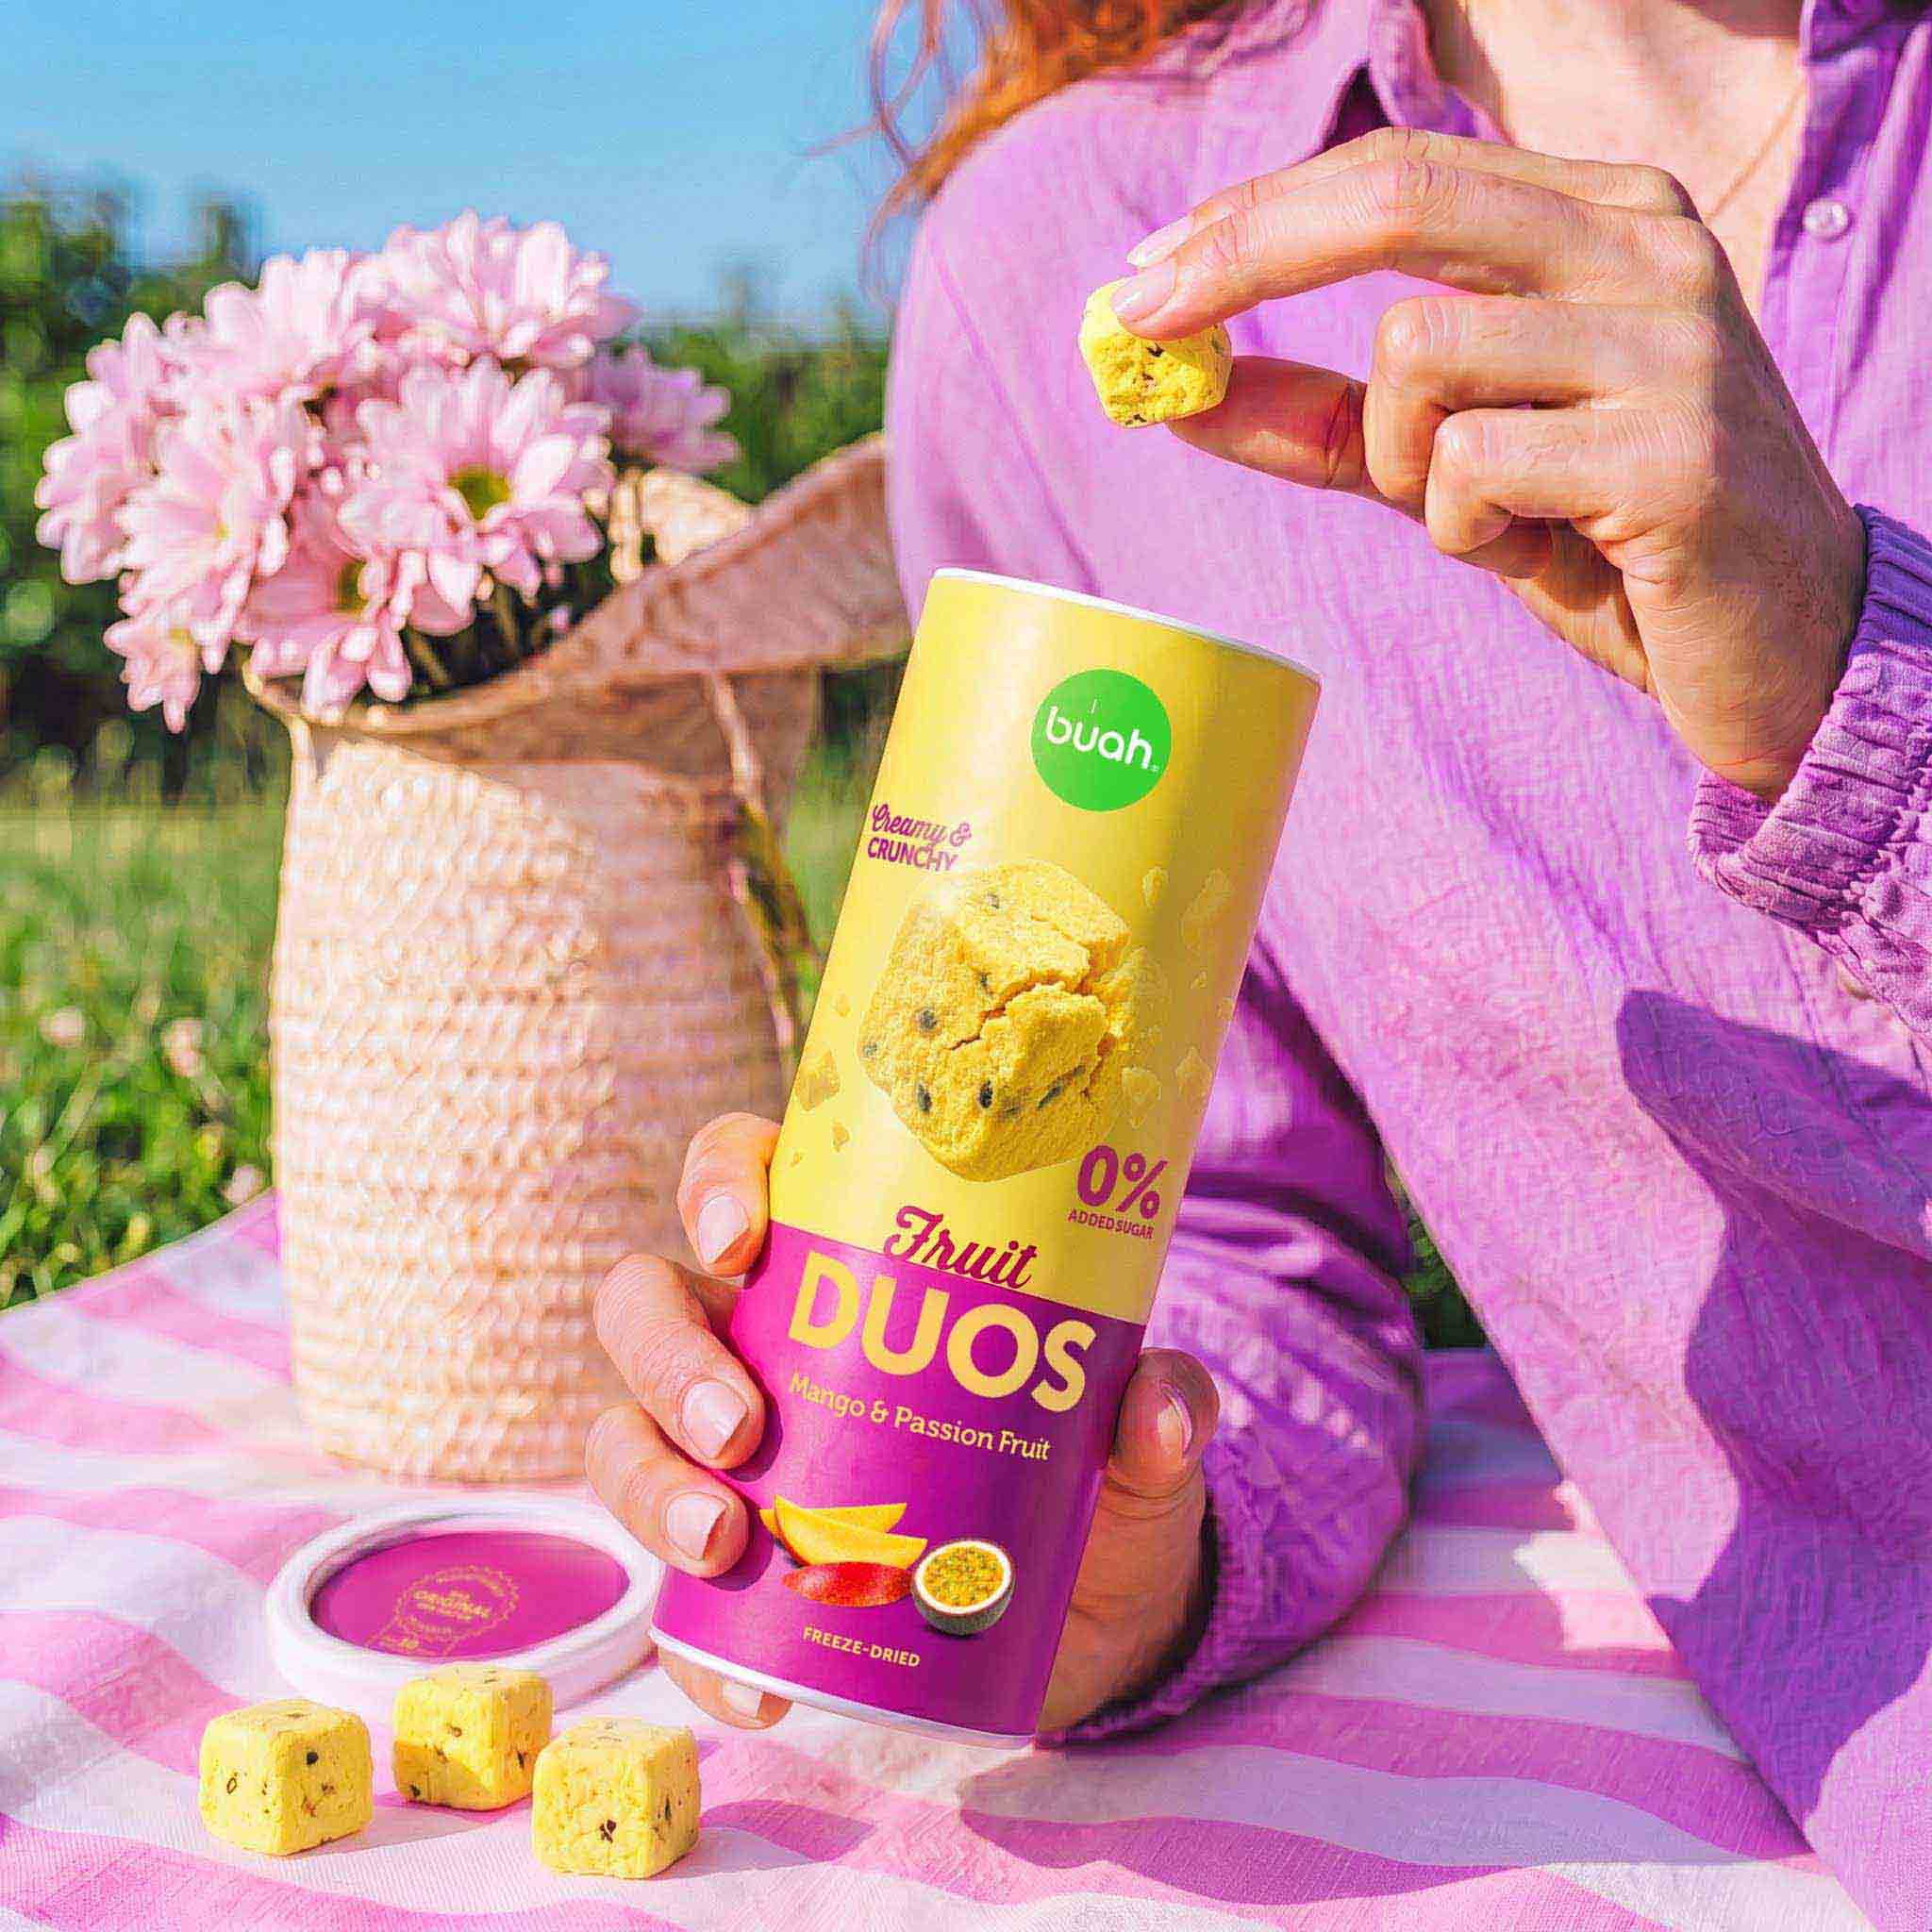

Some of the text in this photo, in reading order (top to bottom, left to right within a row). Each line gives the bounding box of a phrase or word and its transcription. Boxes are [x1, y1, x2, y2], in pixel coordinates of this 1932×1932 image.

[867, 837, 958, 872] CRUNCHY
[873, 803, 972, 852] Creamy &
[1077, 1144, 1168, 1220] 0%
[883, 1206, 1037, 1289] Fruit
[1067, 1208, 1155, 1240] ADDED SUGAR
[788, 1250, 1097, 1412] DUOS
[789, 1373, 1051, 1460] Mango & Passion Fruit
[803, 1625, 921, 1667] FREEZE-DRIED
